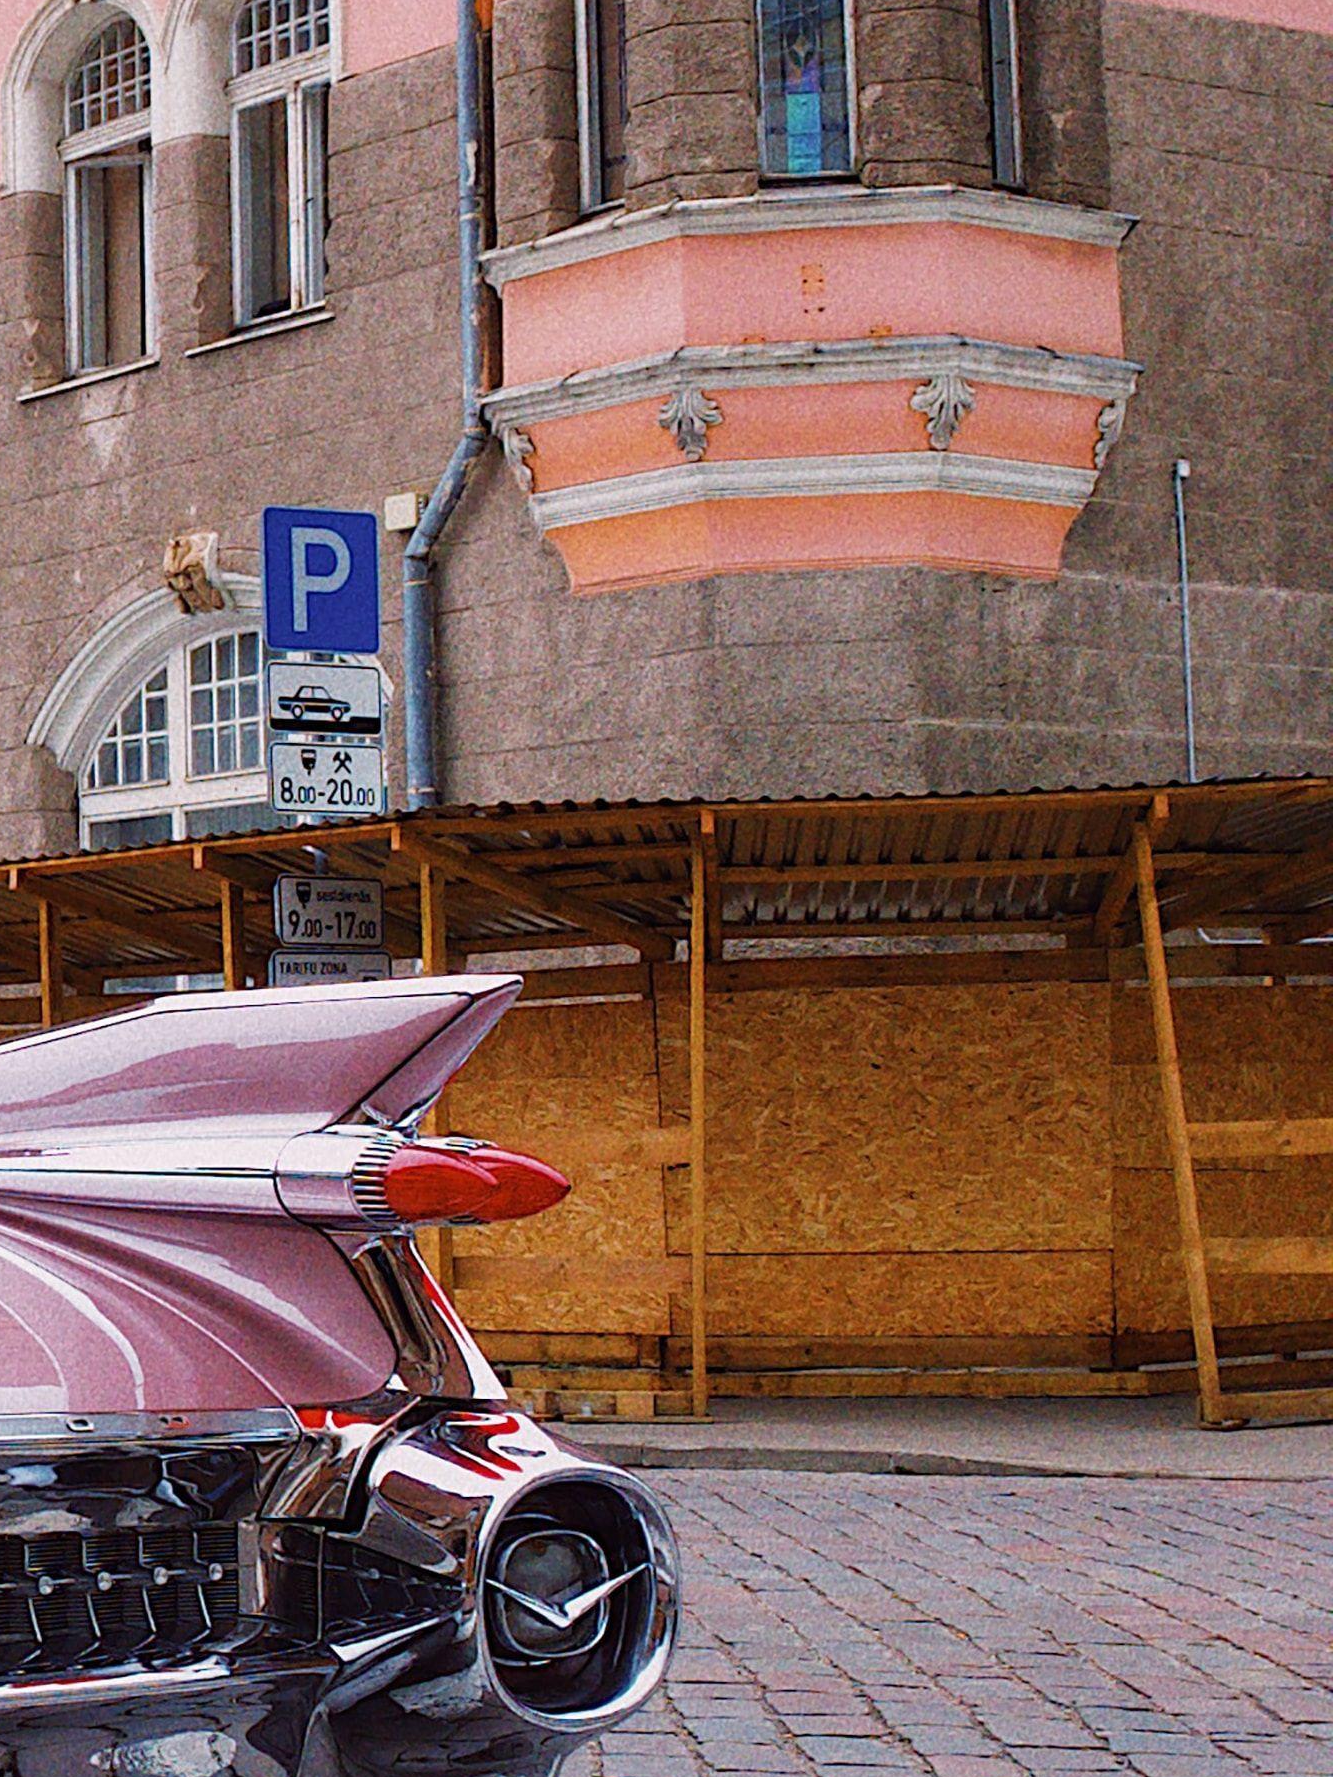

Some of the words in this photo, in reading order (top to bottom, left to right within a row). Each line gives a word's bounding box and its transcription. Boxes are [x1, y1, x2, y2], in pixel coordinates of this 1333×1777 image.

[290, 527, 352, 632] P
[280, 776, 376, 806] 8.00-20.00
[288, 909, 377, 940] 9.00-17.00
[320, 961, 349, 975] ZONA
